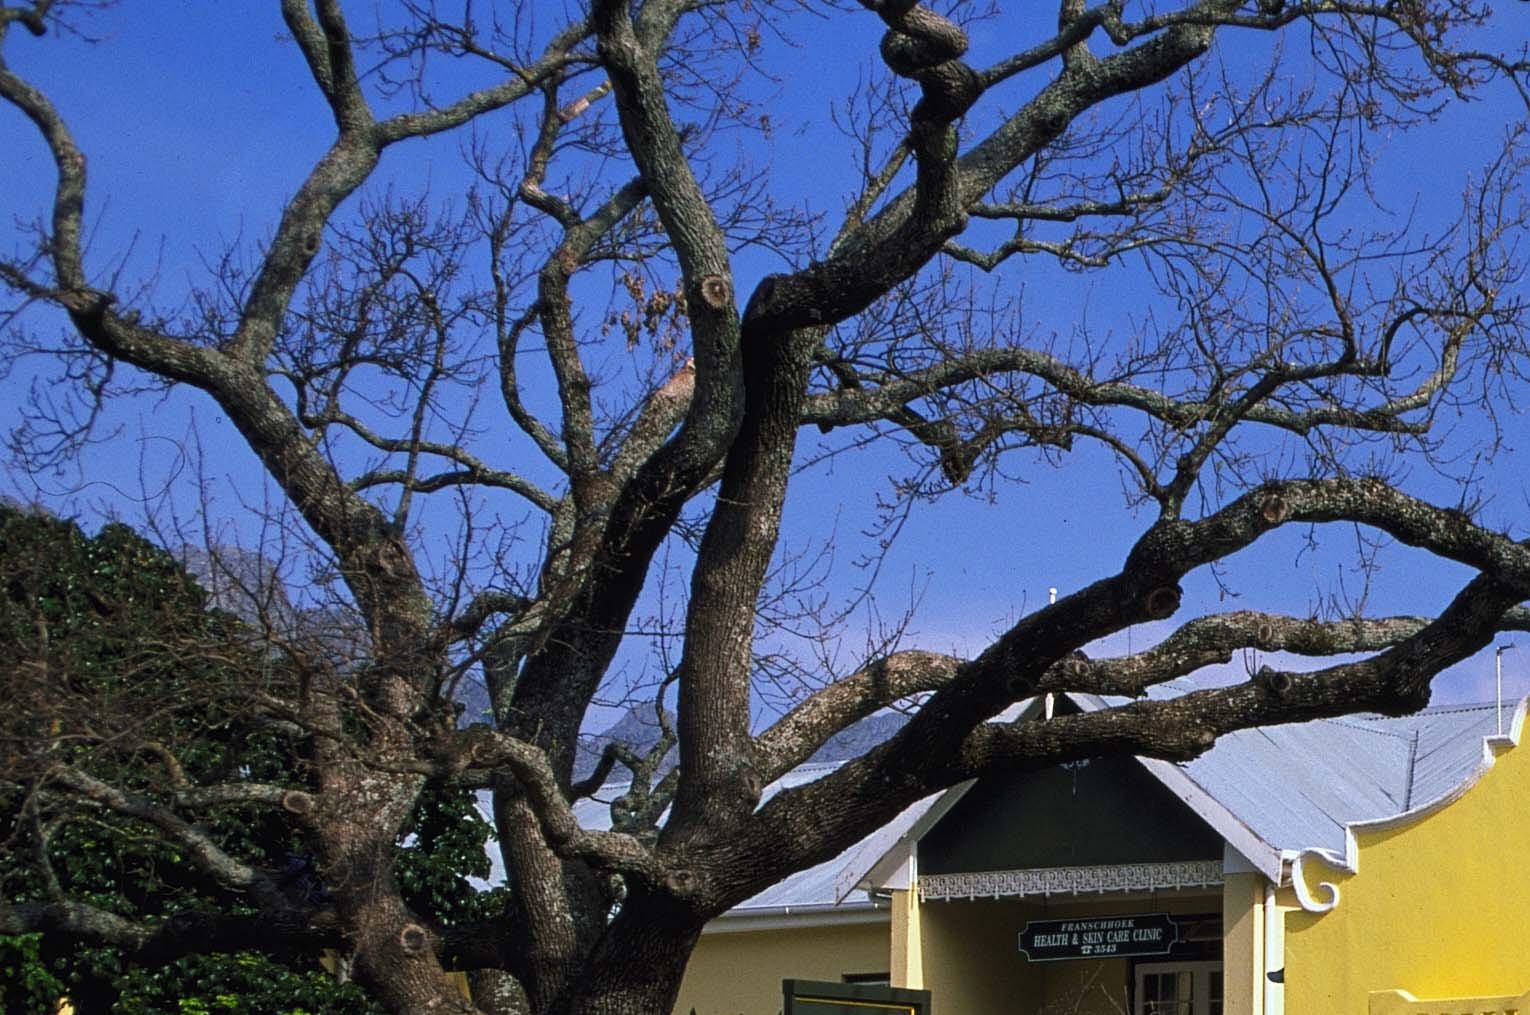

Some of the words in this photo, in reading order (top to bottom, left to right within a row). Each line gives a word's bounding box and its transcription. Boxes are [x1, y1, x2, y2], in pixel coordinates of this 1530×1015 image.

[1061, 919, 1135, 932] FRANSCHHOEK
[1033, 933, 1069, 948] HEALTH
[1071, 931, 1079, 945] &
[1082, 930, 1105, 945] SKIN
[1106, 930, 1130, 943] CARE
[1132, 927, 1163, 941] CLINIC
[1094, 944, 1117, 954] 3543
